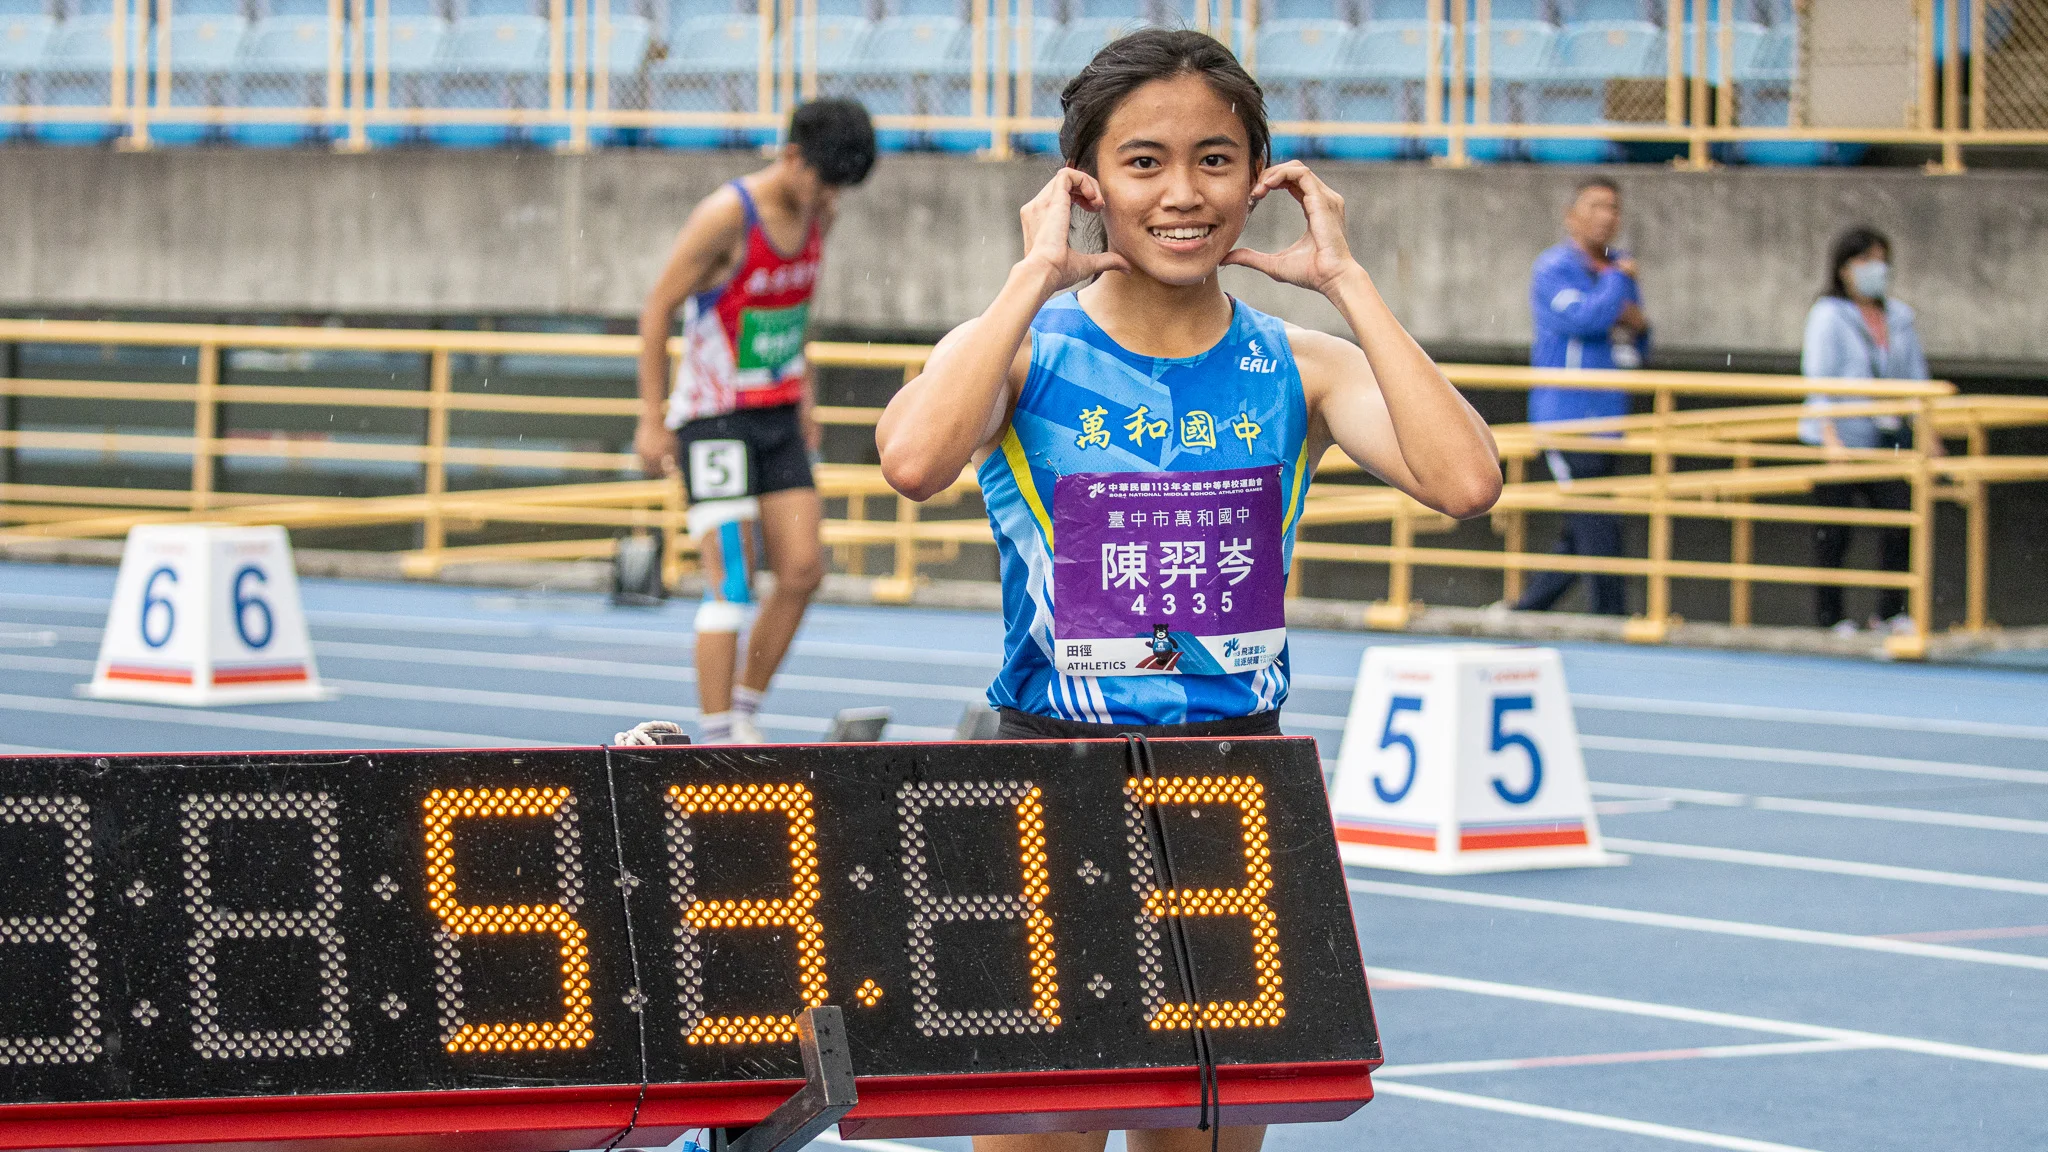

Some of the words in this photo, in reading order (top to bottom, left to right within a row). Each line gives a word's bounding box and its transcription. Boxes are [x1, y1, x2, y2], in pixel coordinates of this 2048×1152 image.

[1239, 356, 1278, 374] EALI
[1076, 404, 1263, 456] 萬和國中
[706, 449, 729, 488] 5
[1107, 505, 1250, 529] 臺中市萬和國中
[1101, 537, 1255, 591] 陳羿岑
[141, 566, 179, 648] 6
[232, 566, 273, 648] 6
[1066, 644, 1093, 658] 田徑
[1066, 661, 1127, 670] ATHLETICS
[1373, 696, 1423, 804] 5
[1492, 696, 1543, 805] 5
[424, 774, 1287, 1053] 53.13
